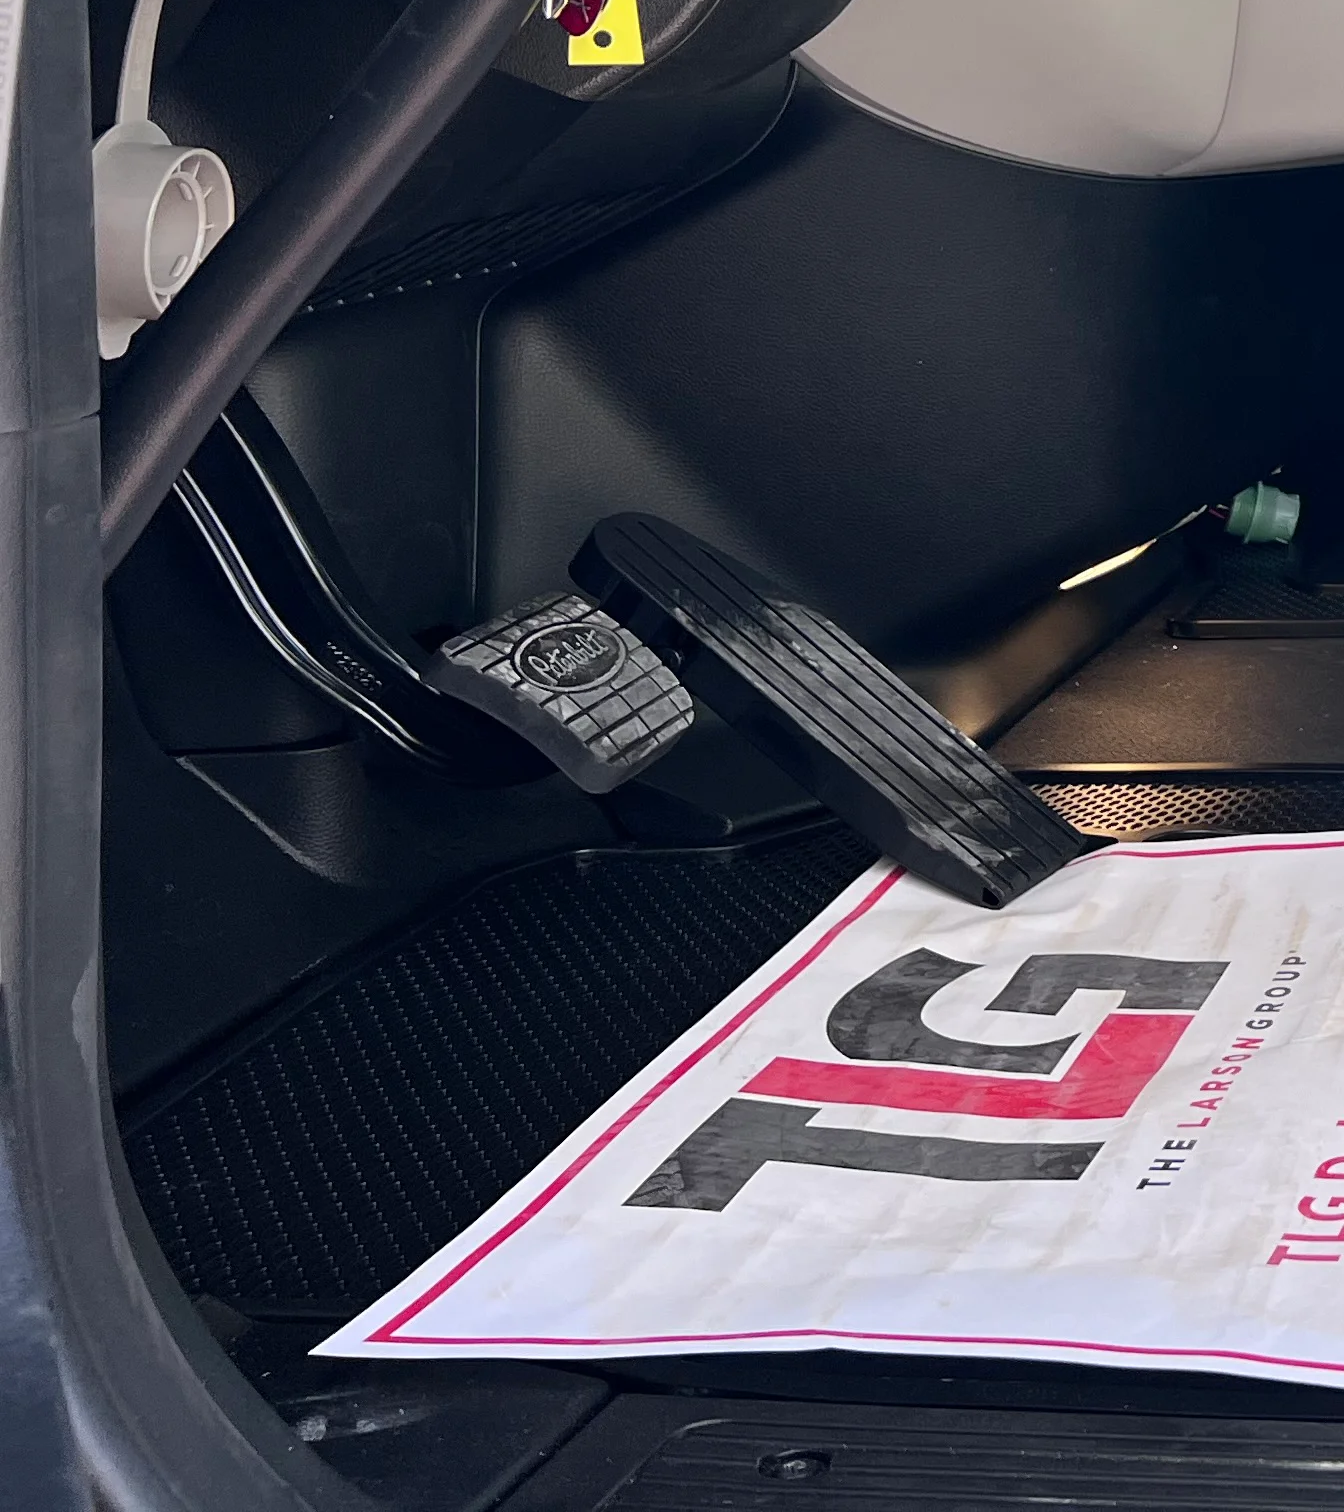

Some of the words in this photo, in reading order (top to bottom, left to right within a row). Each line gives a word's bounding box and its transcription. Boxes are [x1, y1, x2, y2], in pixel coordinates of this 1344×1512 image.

[528, 630, 610, 686] Peterbilt
[622, 948, 1231, 1212] TLG
[1136, 1137, 1196, 1191] THE
[1175, 1036, 1262, 1130] LARSON
[1245, 955, 1307, 1031] GROUP
